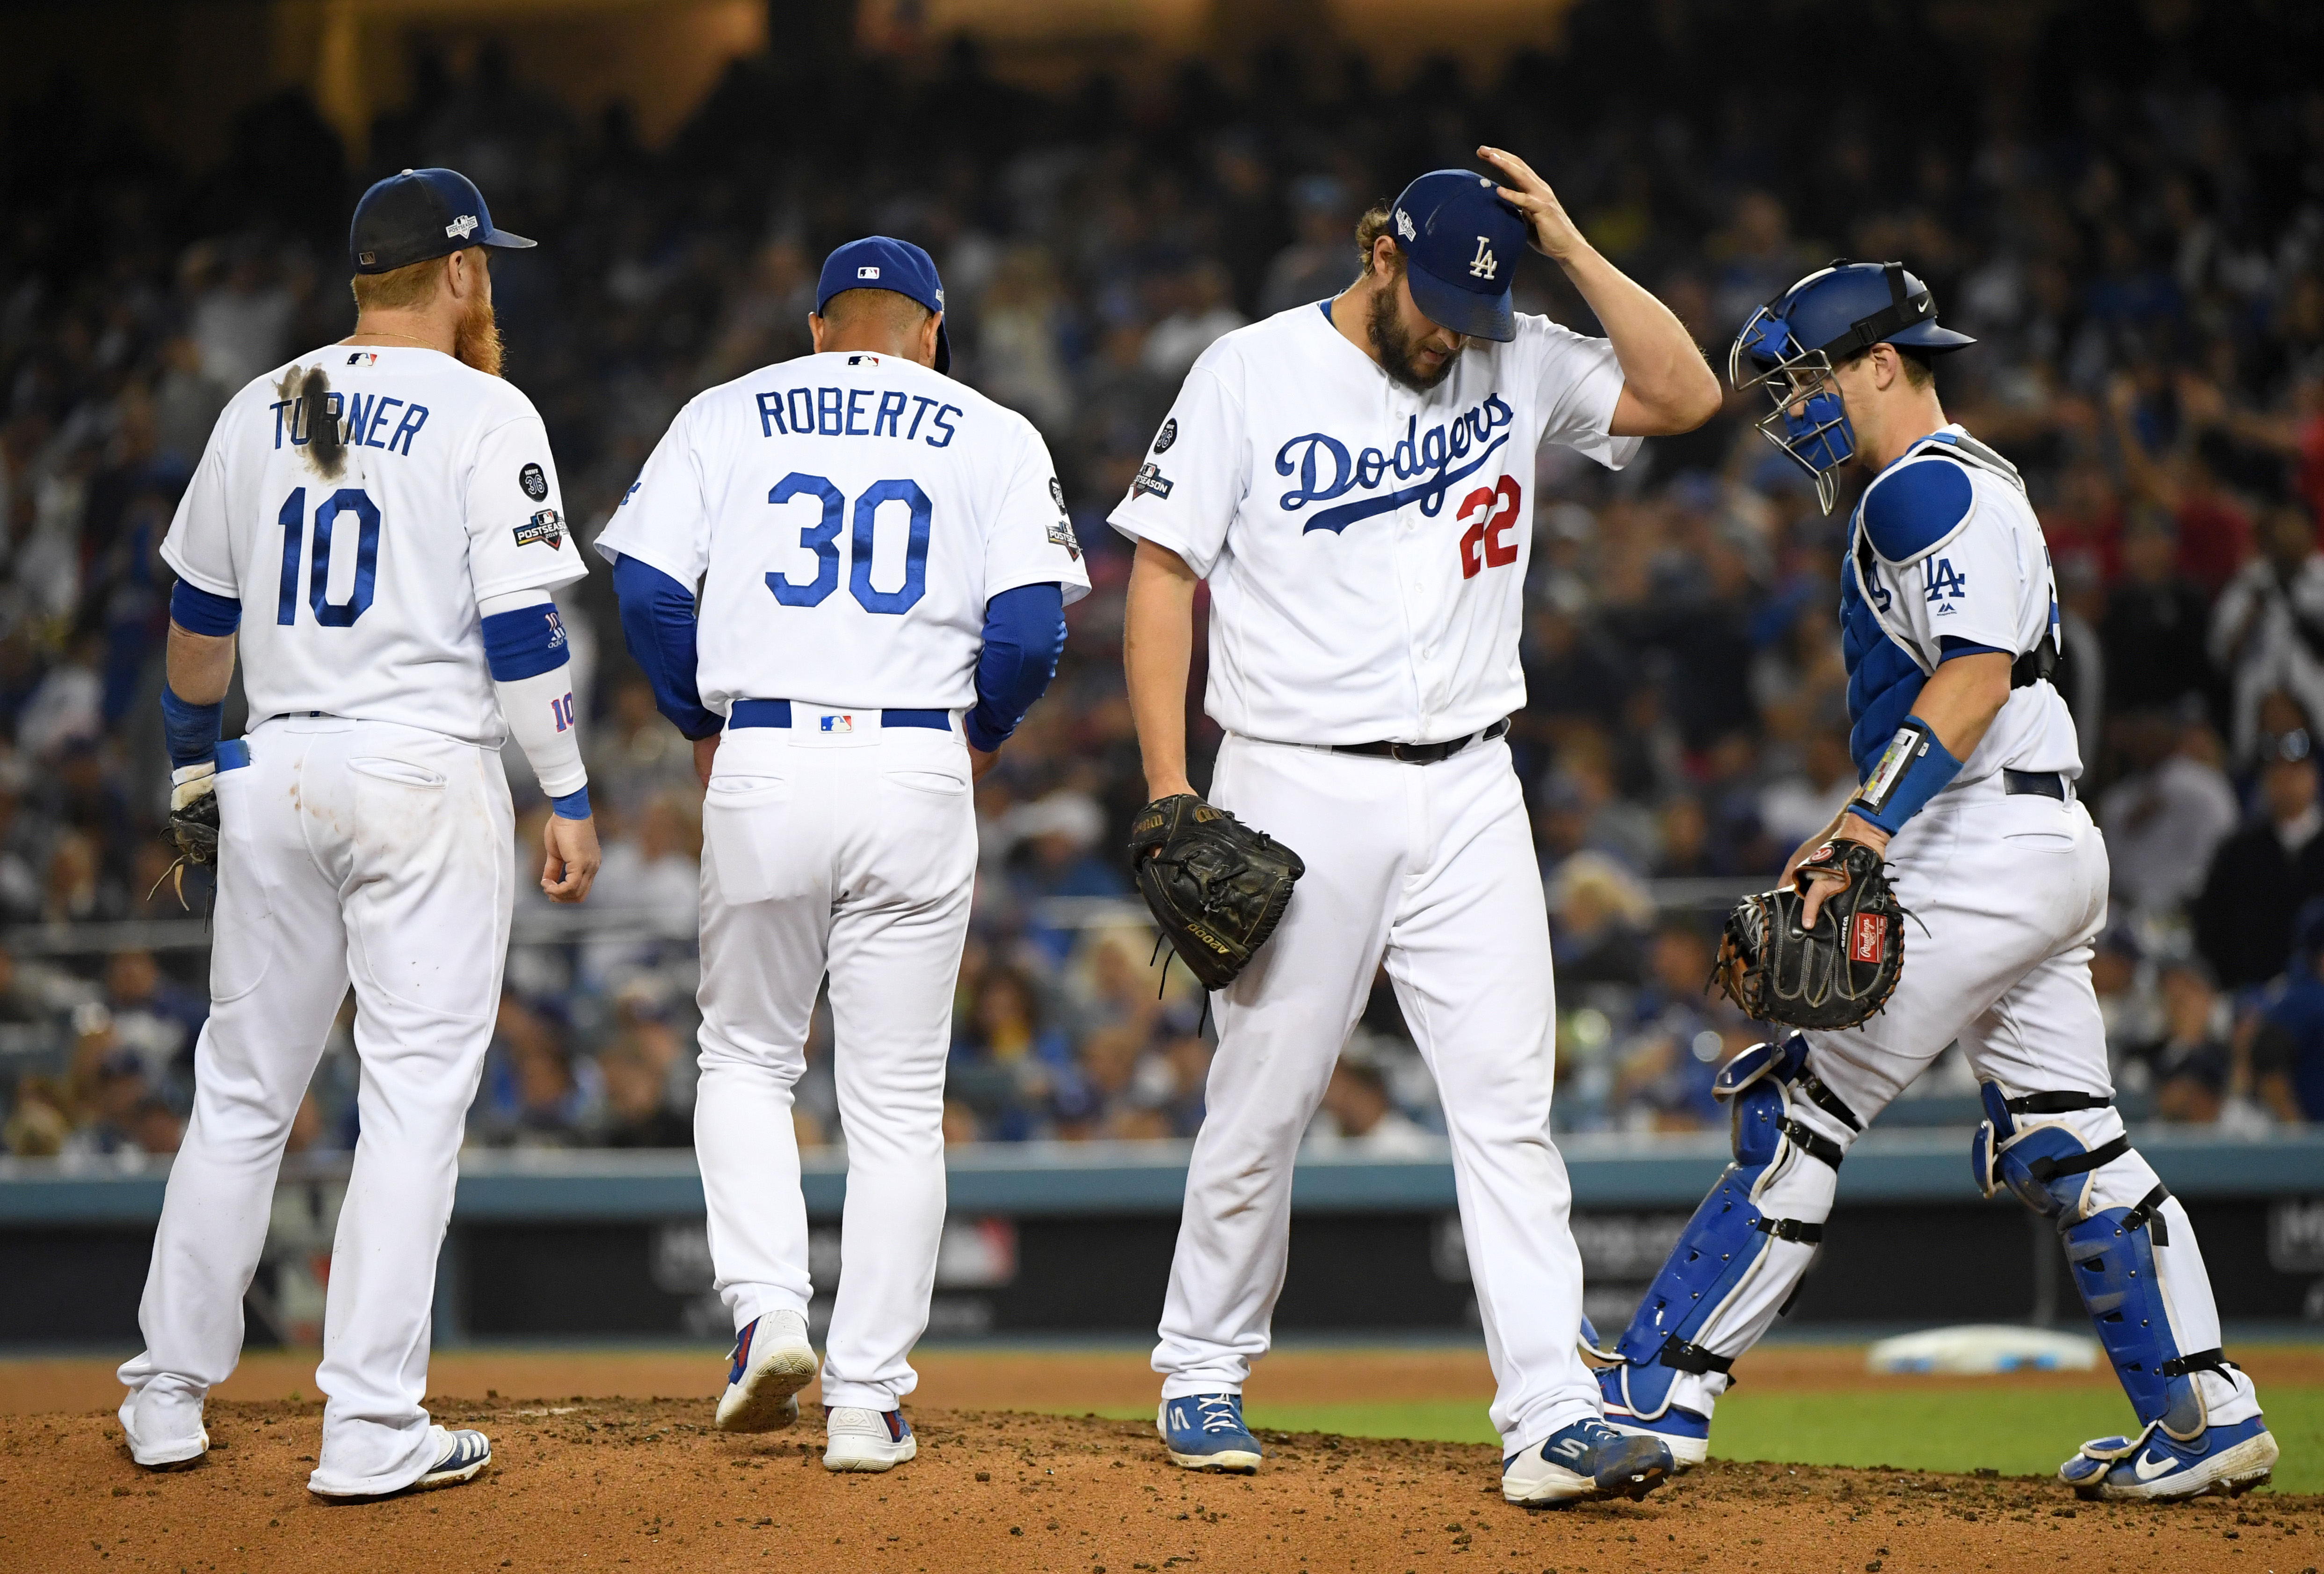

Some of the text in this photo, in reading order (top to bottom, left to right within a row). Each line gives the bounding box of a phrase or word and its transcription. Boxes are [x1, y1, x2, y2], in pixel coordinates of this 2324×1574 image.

[448, 219, 476, 233] POSTSEASON
[1470, 236, 1497, 280] LA
[270, 392, 429, 457] TURNER
[756, 387, 964, 448] ROBERTS
[1275, 392, 1514, 520] Dodgers
[525, 474, 545, 495] 36
[1134, 474, 1168, 493] STSEASON
[517, 521, 566, 540] POSTSEASO
[764, 472, 933, 615] 30
[1049, 530, 1077, 544] POSTSEA
[1457, 474, 1522, 580] 22
[277, 487, 382, 627] 10
[1924, 554, 1965, 603] LA
[551, 691, 574, 733] 10
[1188, 923, 1230, 954] A2000
[1859, 918, 1875, 958] Rawlings
